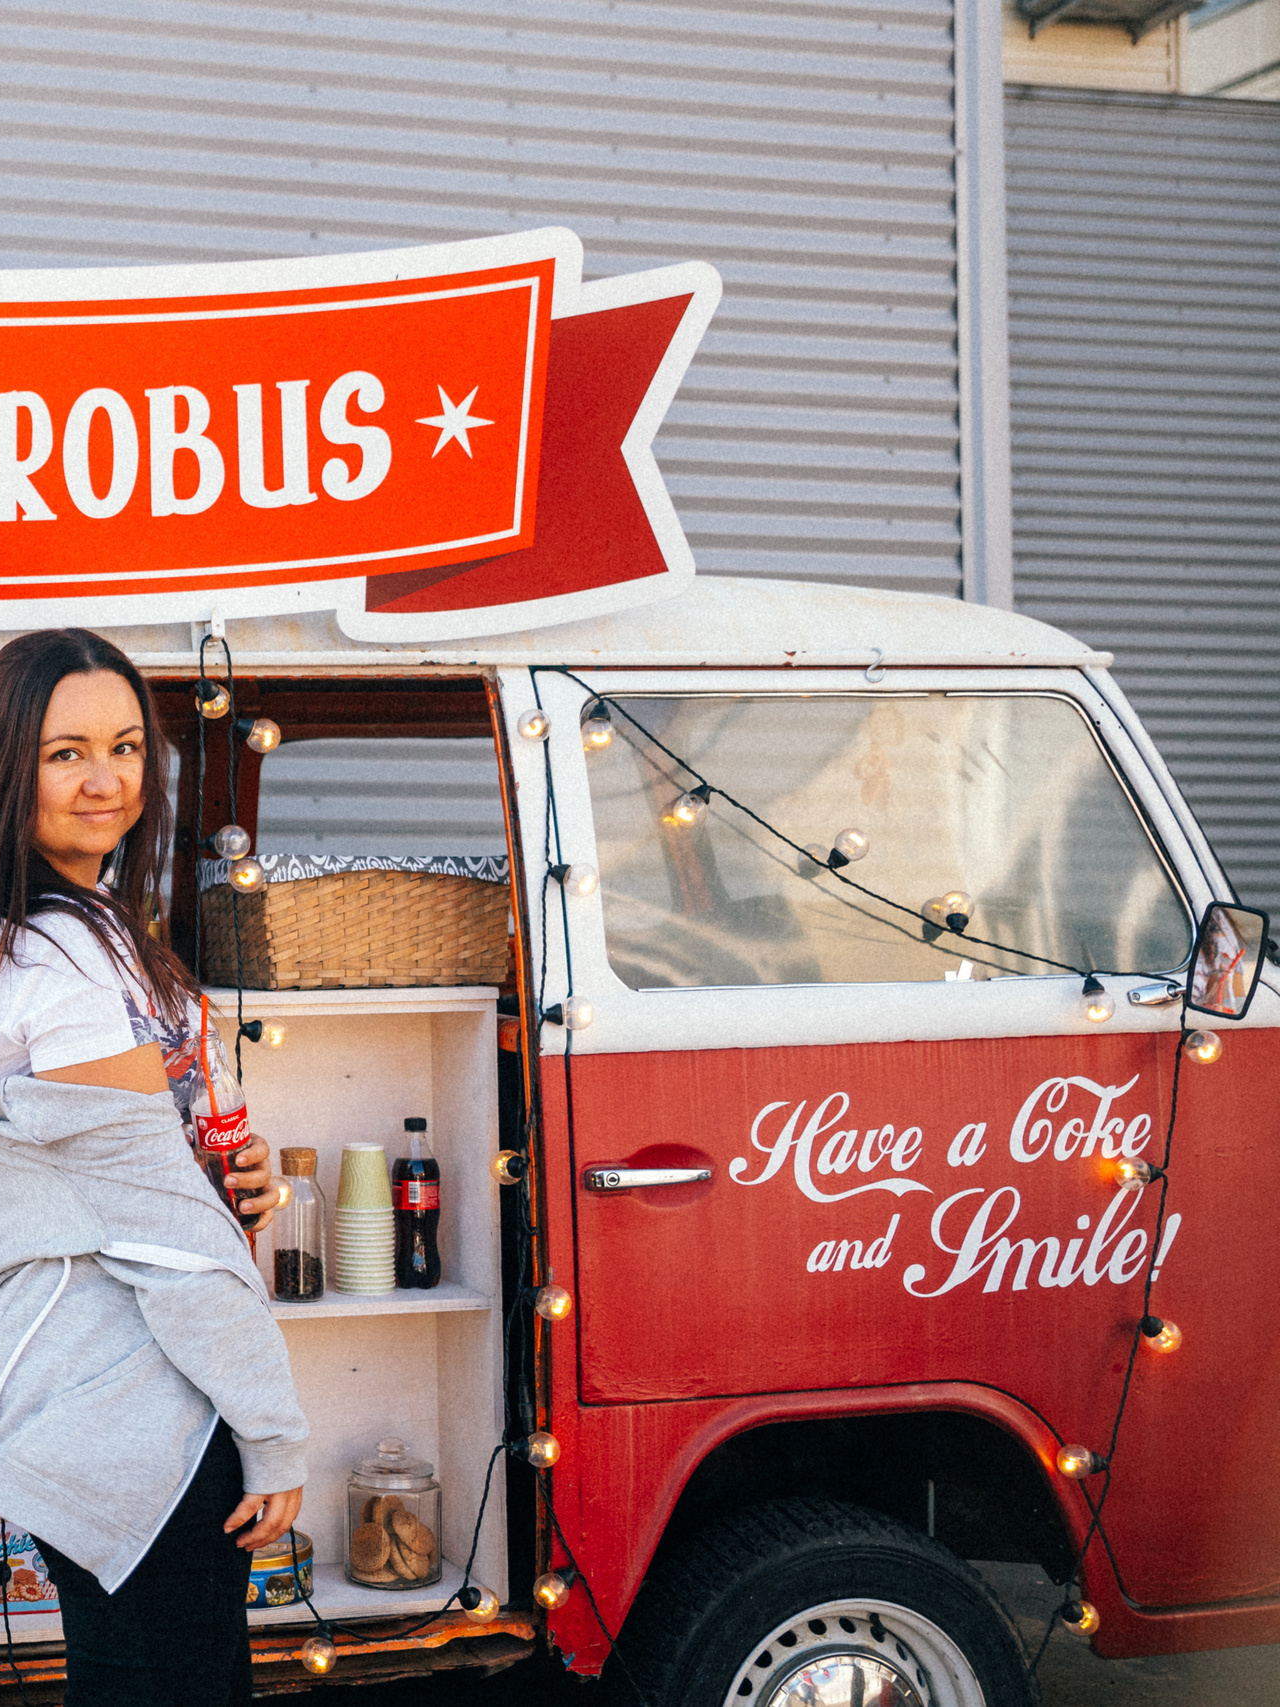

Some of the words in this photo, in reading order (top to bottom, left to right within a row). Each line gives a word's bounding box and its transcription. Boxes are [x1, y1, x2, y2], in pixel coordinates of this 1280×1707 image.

[728, 1092, 934, 1203] Have
[946, 1122, 987, 1168] a
[1009, 1074, 1152, 1163] Coke
[806, 1213, 901, 1272] and
[903, 1184, 1182, 1298] Smile!
